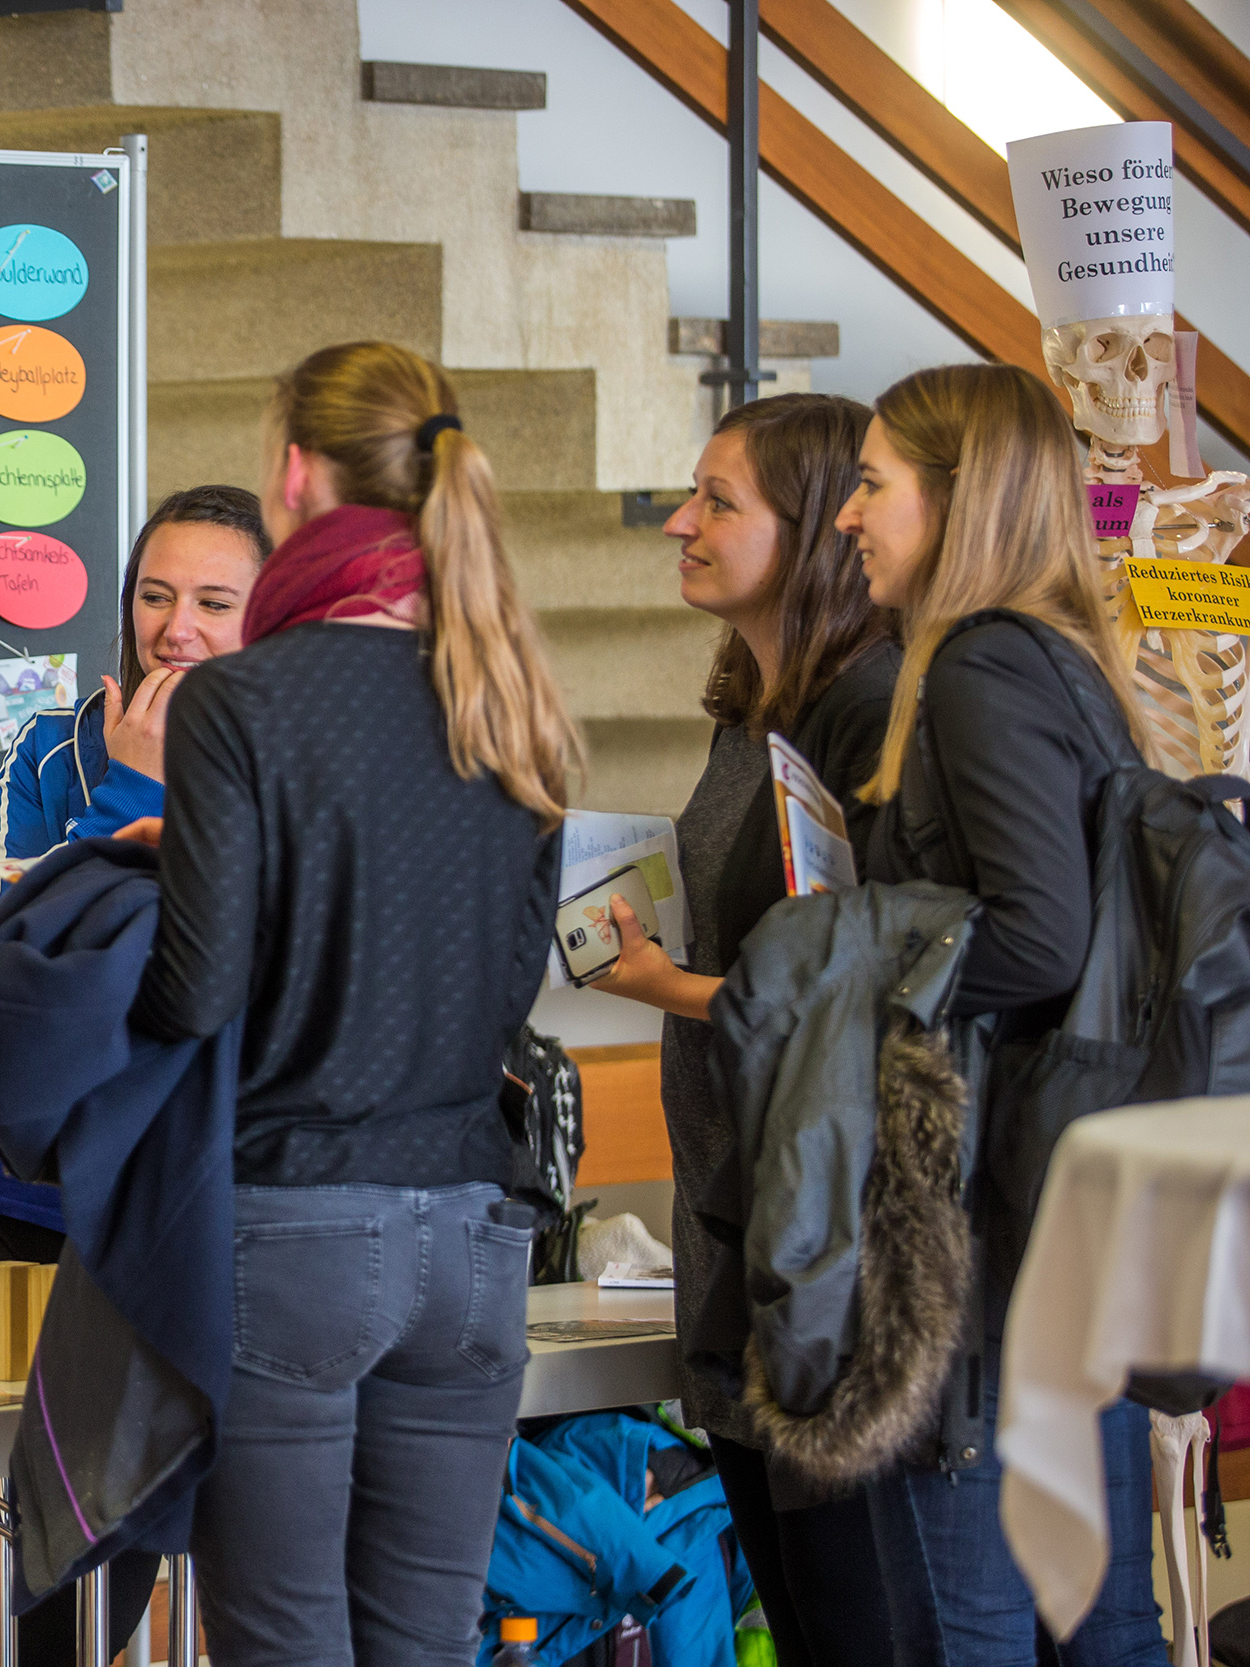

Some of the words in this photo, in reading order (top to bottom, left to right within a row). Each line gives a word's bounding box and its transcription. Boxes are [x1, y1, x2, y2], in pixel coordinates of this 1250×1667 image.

[1041, 166, 1114, 191] Wieso
[1061, 194, 1172, 220] Bewegung
[1085, 226, 1165, 246] unsere
[1058, 251, 1174, 282] Gesundhei
[1092, 491, 1124, 508] als
[1128, 564, 1218, 584] Reduziertes
[1167, 586, 1240, 608] koronarer
